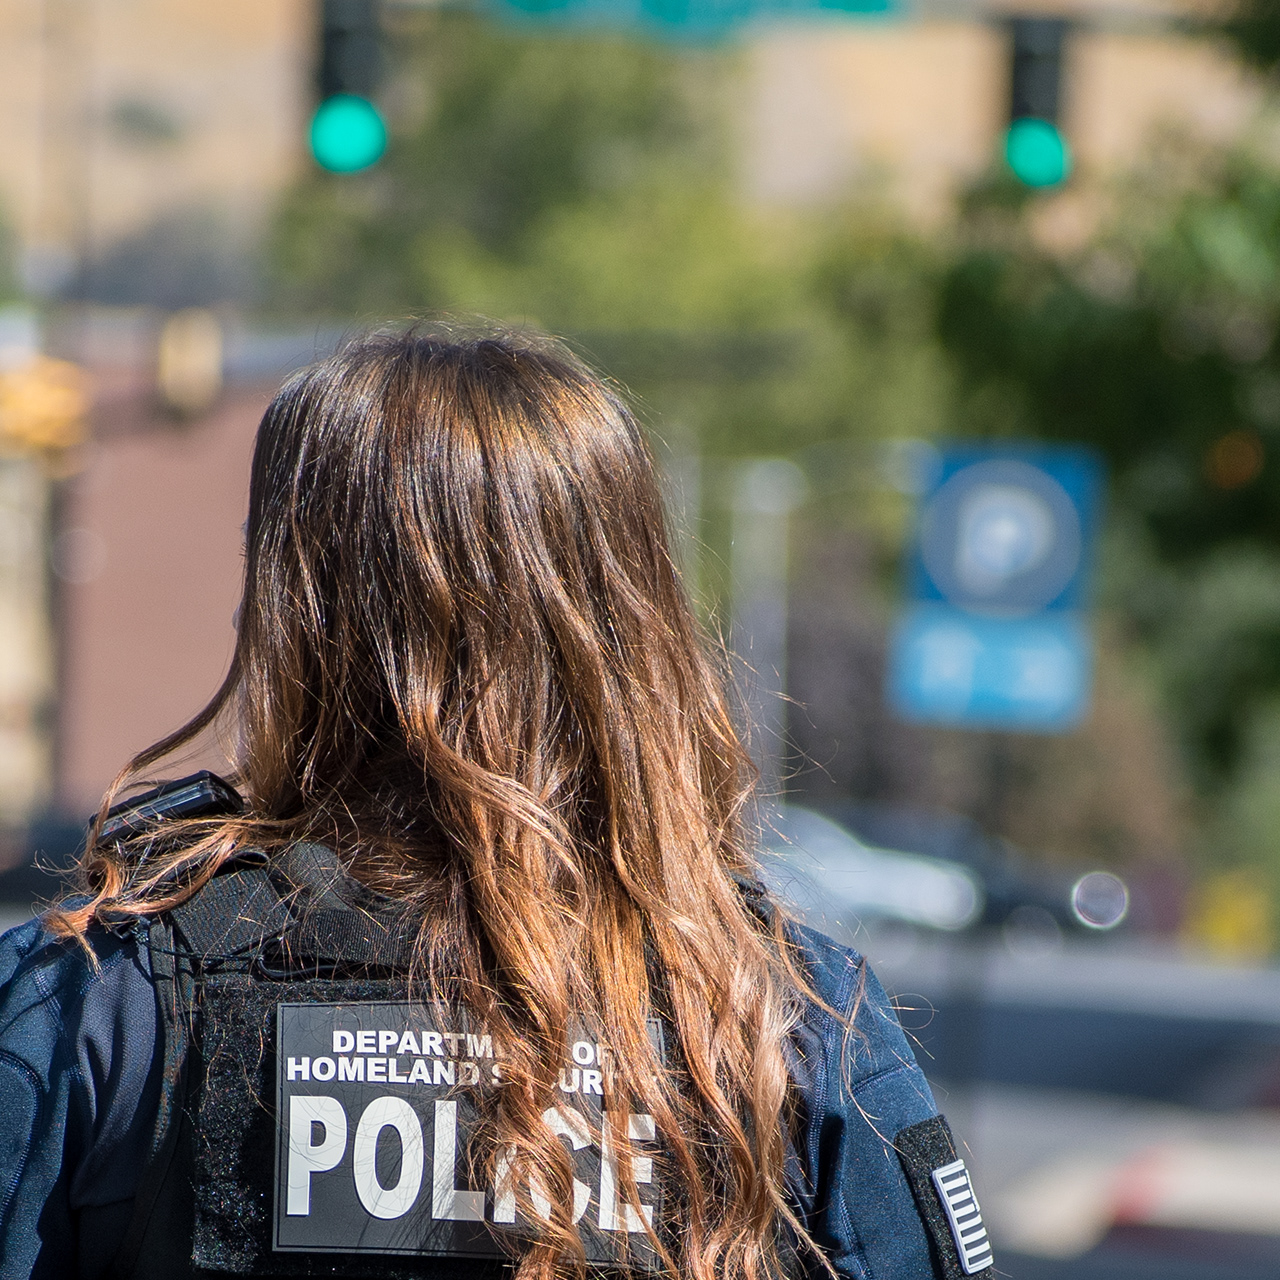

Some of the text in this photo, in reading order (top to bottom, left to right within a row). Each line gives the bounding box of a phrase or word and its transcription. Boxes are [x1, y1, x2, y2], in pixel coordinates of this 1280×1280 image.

[958, 485, 1054, 594] P
[287, 1057, 480, 1085] HOMELAND
[332, 1031, 504, 1059] DEPARTM
[286, 1095, 656, 1233] POLICE
